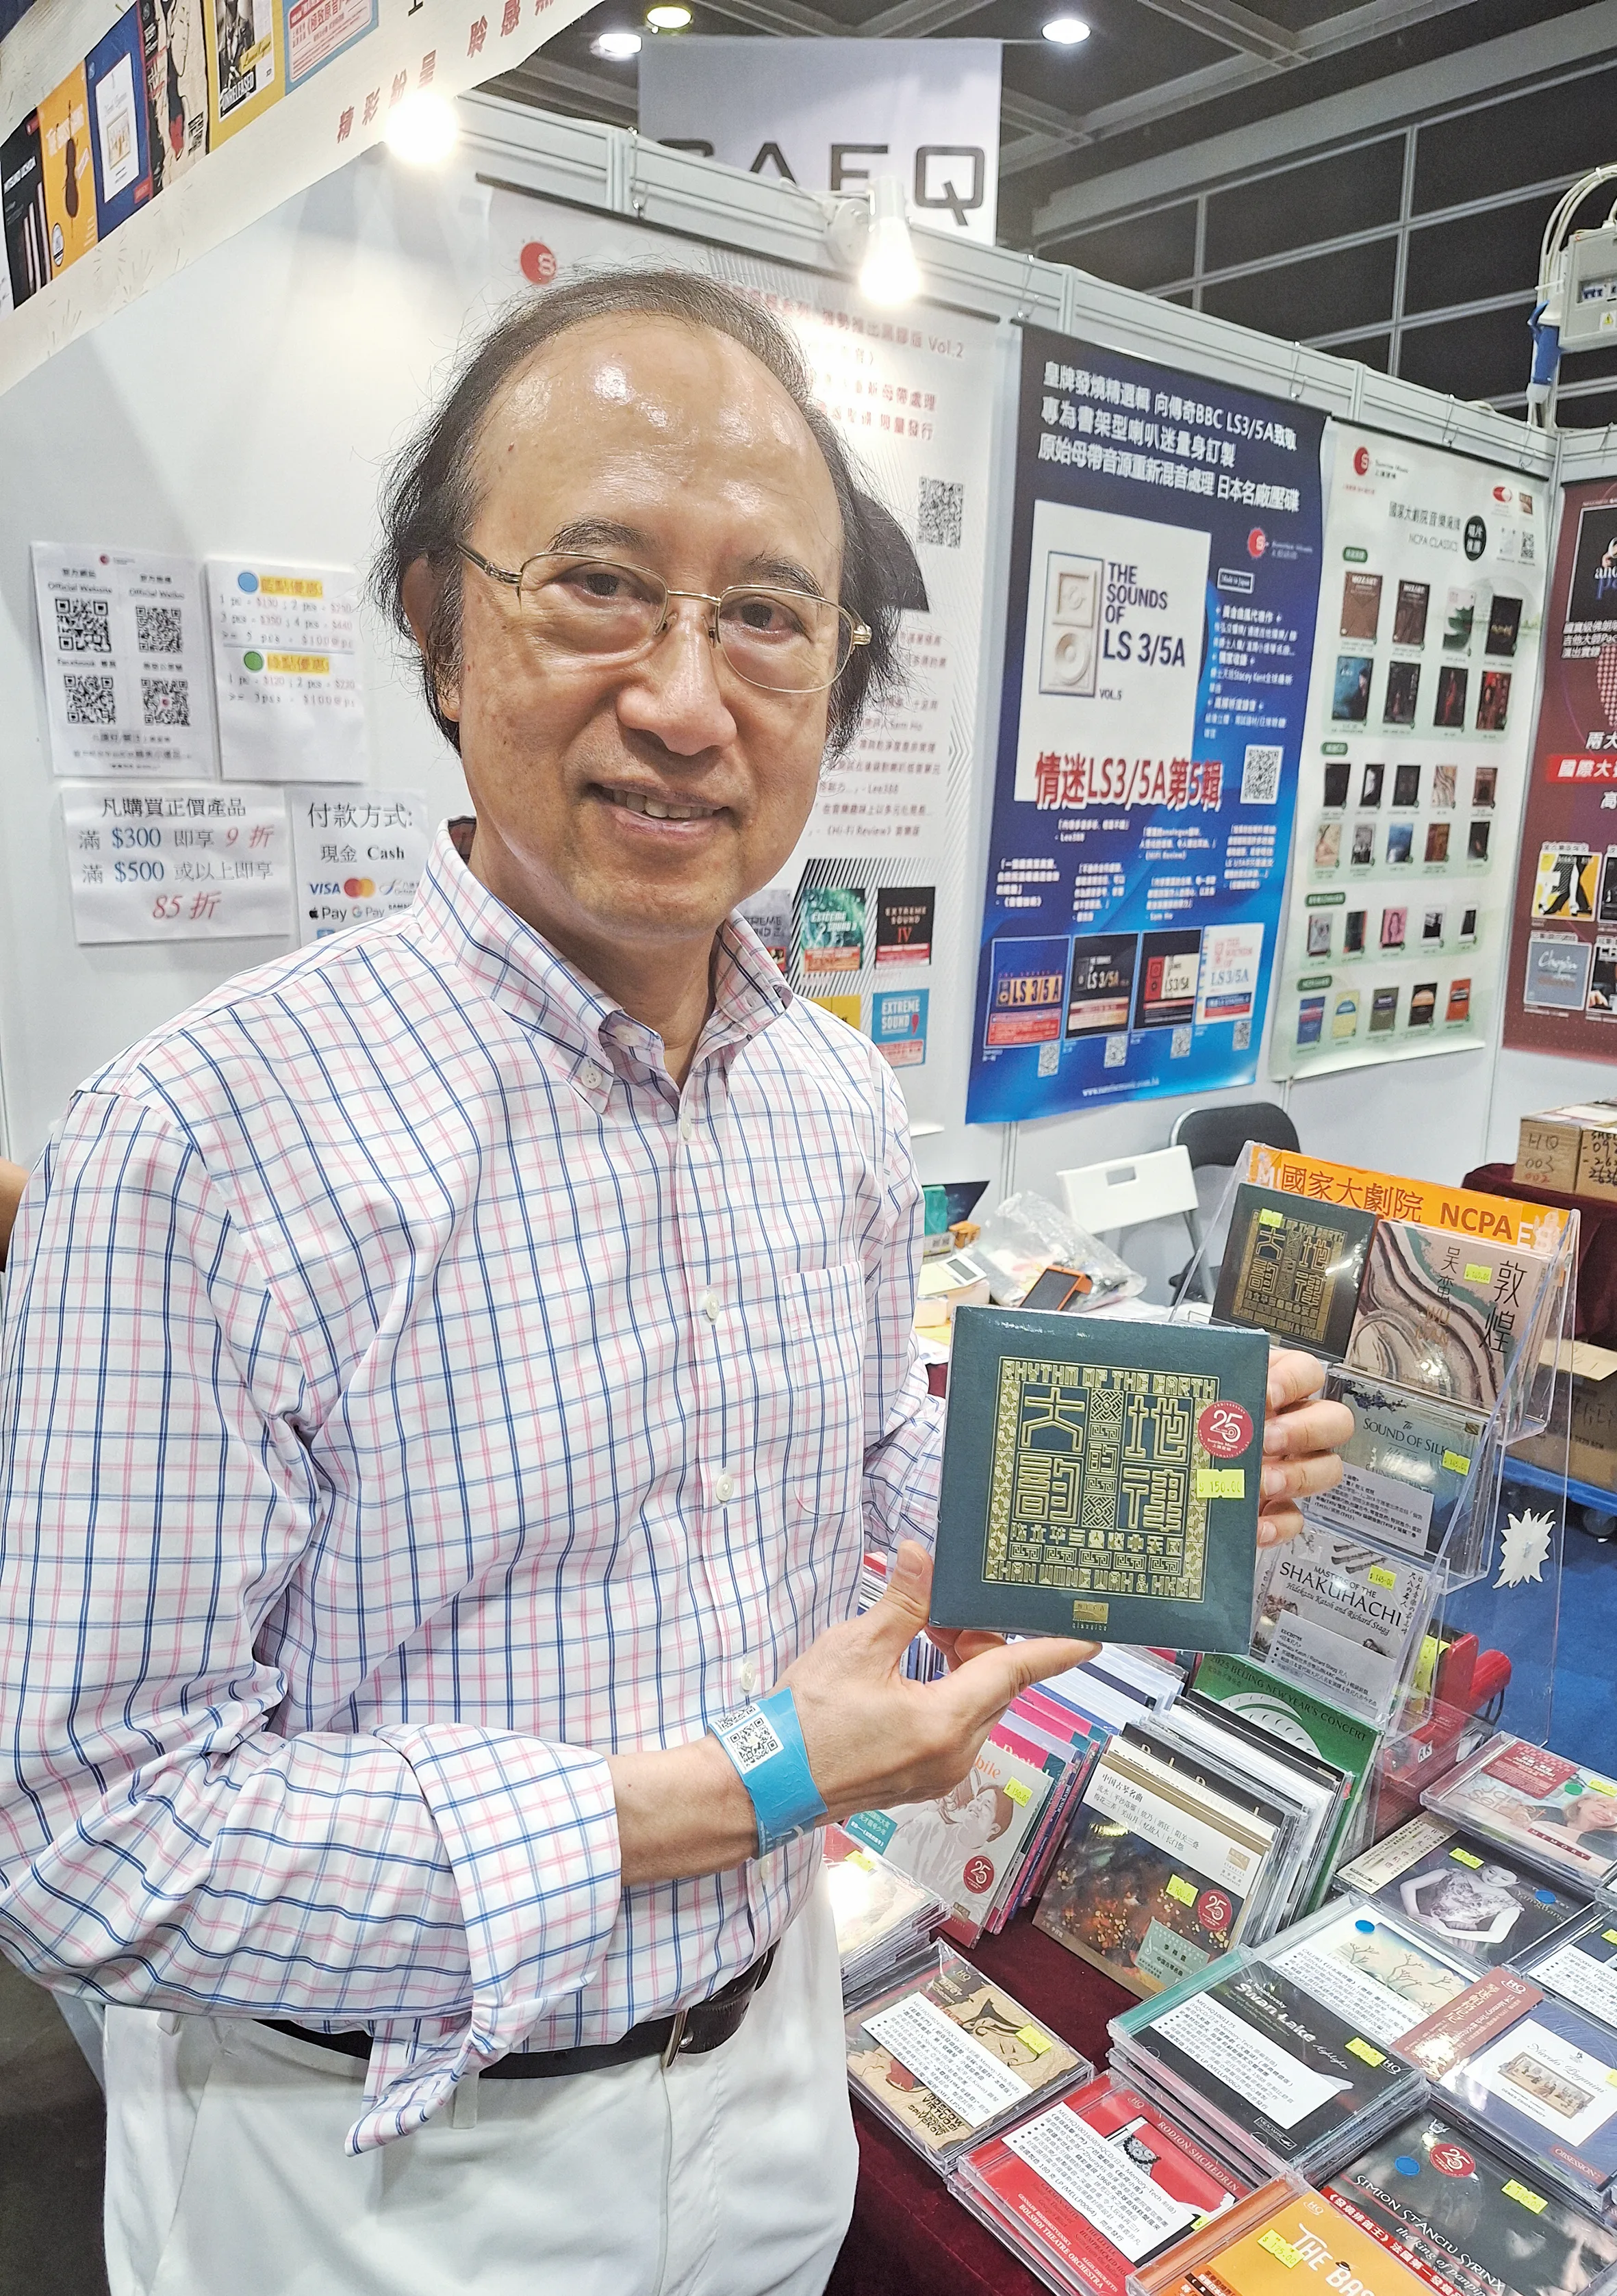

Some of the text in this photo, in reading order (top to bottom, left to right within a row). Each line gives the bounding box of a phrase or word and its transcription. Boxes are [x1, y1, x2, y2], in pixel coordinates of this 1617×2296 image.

[928, 335, 965, 358] Vol.2
[1108, 562, 1138, 585] THE
[1106, 583, 1169, 611] SOUNDS
[1106, 604, 1125, 625] OF
[1103, 628, 1186, 668] LS 3/5A
[1035, 751, 1224, 813] 情迷LS3/5A第5輯
[101, 796, 246, 819] 凡購買正價產品
[306, 802, 413, 830] 付款方式:
[78, 824, 275, 851] 滿 $300 即享 9 折
[320, 843, 405, 863] 現金 Cash
[81, 860, 274, 884] 滿 $500 或以上即享
[309, 882, 342, 896] VISA
[151, 890, 223, 921] 85 折
[884, 906, 927, 917] EXTREME
[891, 915, 921, 926] SOUND
[897, 927, 913, 944] IV
[881, 997, 921, 1015] EXTREME
[881, 1014, 910, 1030] SOUND
[1281, 1163, 1514, 1241] 國家大劇院 NCPA
[1479, 1260, 1528, 1353] 敦煌
[1002, 1360, 1216, 1399] RHYTHM OF THE EARTH
[1210, 1409, 1244, 1443] 25
[1363, 1418, 1405, 1441] SOUND
[1406, 1435, 1423, 1449] OF
[1279, 1561, 1403, 1628] SHAKUHACHI
[1349, 1581, 1360, 1591] OF
[1362, 1585, 1377, 1598] THE
[1314, 1594, 1334, 1609] Katoh
[1334, 1605, 1347, 1615] and
[1347, 1607, 1372, 1627] Richard
[1371, 1622, 1391, 1637] Stagg
[1231, 1665, 1264, 1688] BEIJING
[1266, 1683, 1287, 1700] NEW
[1321, 1713, 1366, 1742] CONCERT
[1101, 1772, 1144, 1803] 中国古琴名曲
[1530, 1829, 1590, 1859] MEMORY
[970, 1860, 991, 1884] 25
[1208, 1896, 1227, 1922] 25
[956, 1969, 971, 1981] HQ
[1504, 1978, 1528, 1995] HQ
[1252, 1982, 1288, 2009] Tchaikovsky
[1234, 1982, 1278, 2017] Swan
[1277, 2013, 1317, 2043] Lake
[1217, 2023, 1255, 2050] Memory-Tech
[1382, 2059, 1402, 2074] HQ
[1561, 2065, 1608, 2094] Paganini
[921, 2097, 958, 2132] VIRTUOSI
[926, 2092, 967, 2128] MOSCOW
[1130, 2096, 1145, 2108] HQ
[1156, 2120, 1239, 2193] RODION SHCHEDRIN
[1442, 2147, 1471, 2171] 25
[1553, 2147, 1594, 2176] OBSESSION
[1123, 2168, 1164, 2202] Memory-Tech
[1307, 2200, 1325, 2215] HQ
[1329, 2193, 1391, 2244] 《發燒排笛王》
[1018, 2204, 1104, 2290] BOLSHOI THEATRE ORCHESTRA
[1293, 2222, 1334, 2271] THE
[1351, 2173, 1506, 2293] SIMION STANCIU SYRINX
[1270, 2242, 1297, 2265] 175.00
[1395, 2225, 1451, 2273] the king of
